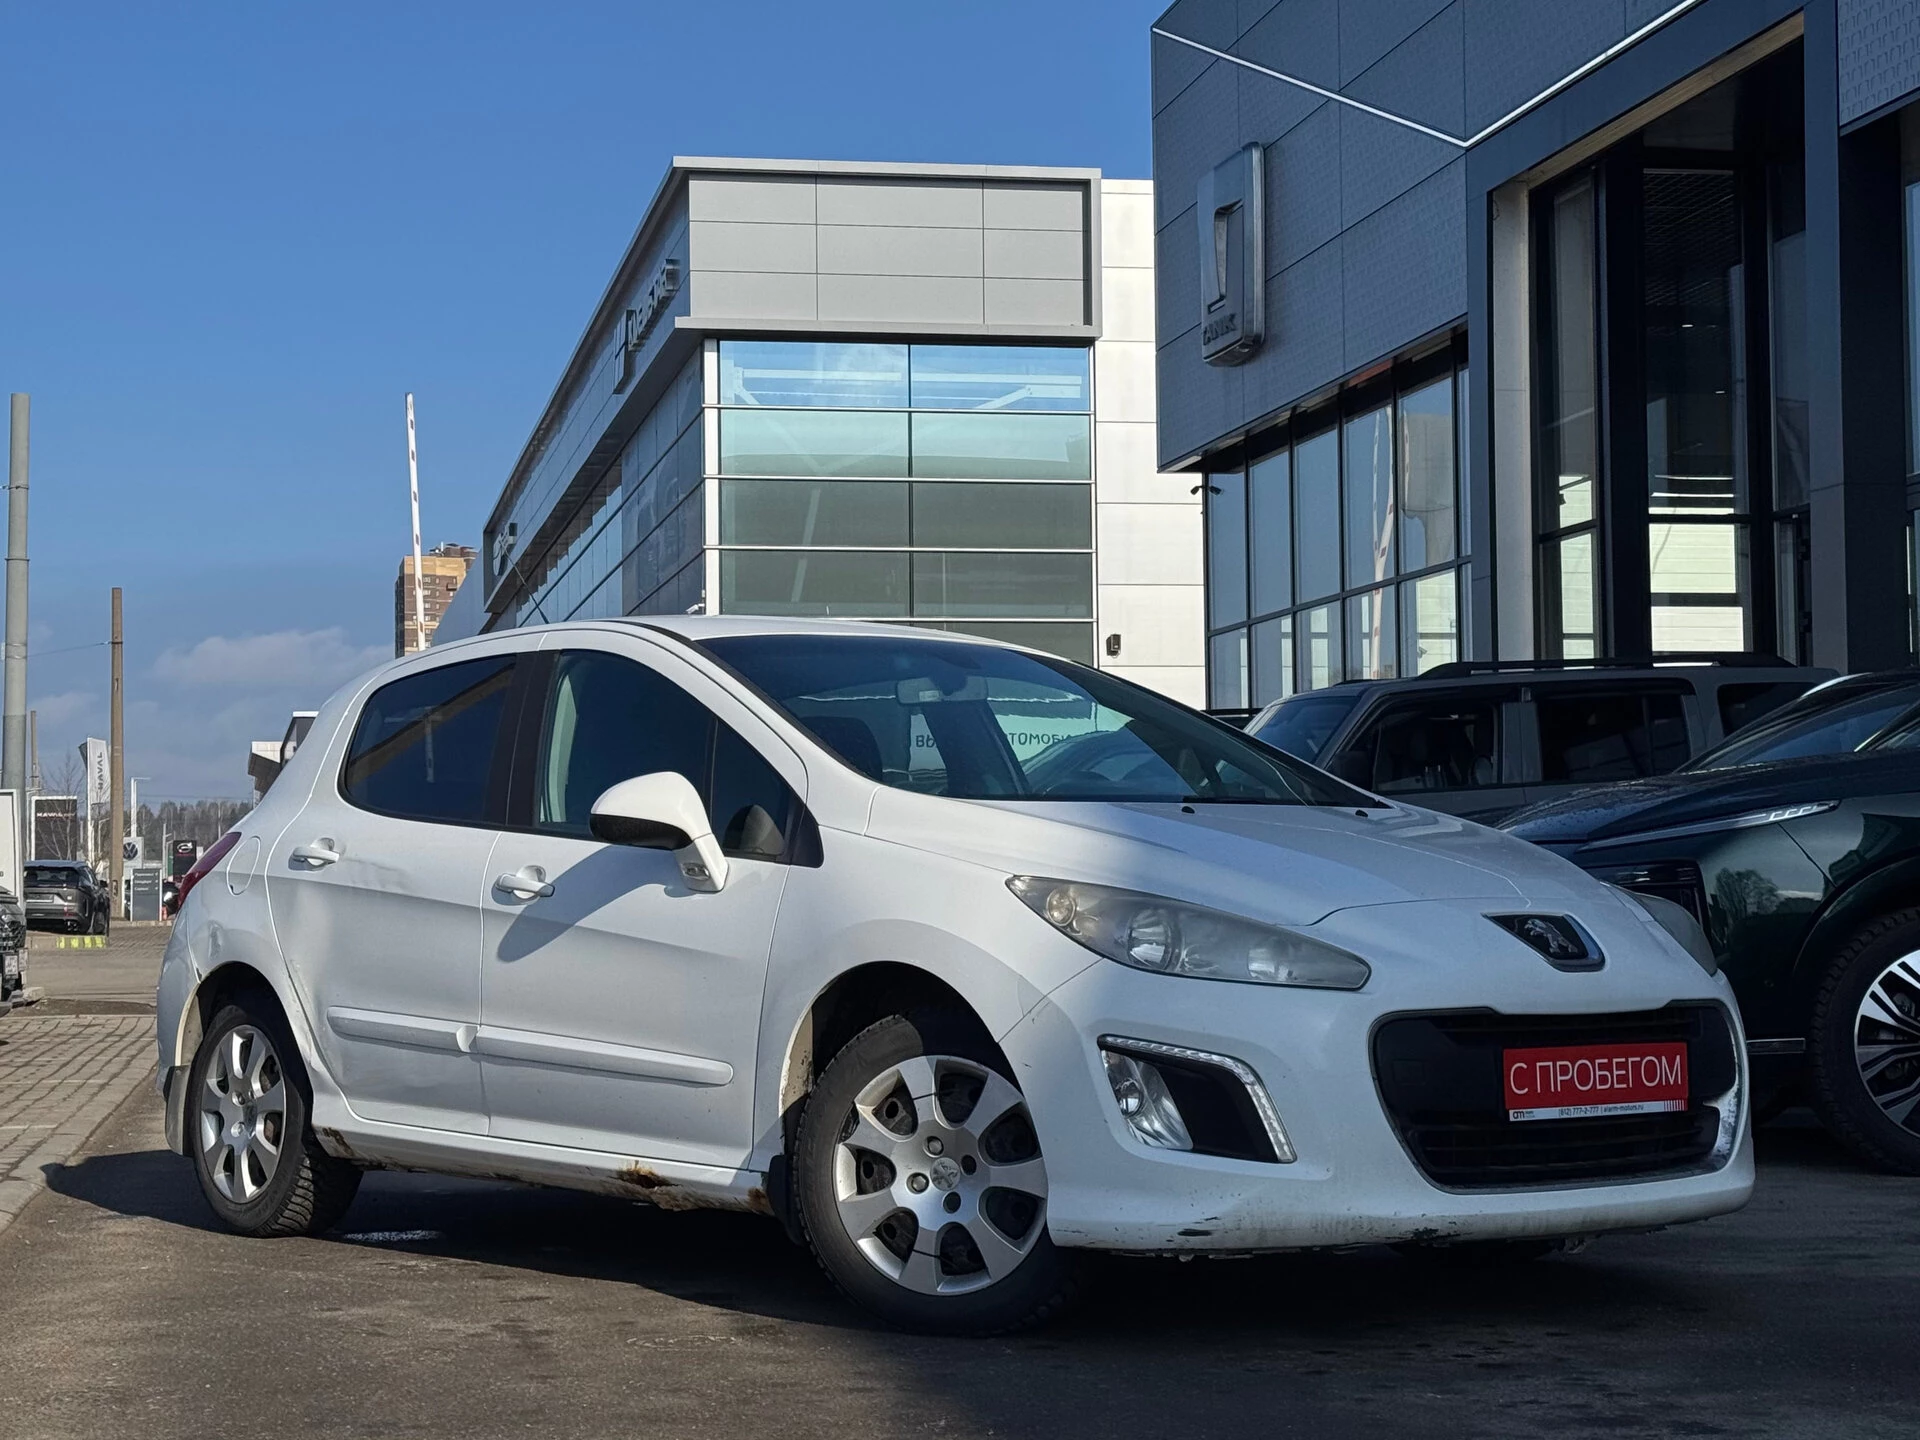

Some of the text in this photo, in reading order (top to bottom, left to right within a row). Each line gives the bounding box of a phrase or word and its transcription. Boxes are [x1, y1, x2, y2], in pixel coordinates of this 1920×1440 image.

[1510, 1054, 1683, 1095] С ПРОБЕГОМ
[1573, 1106, 1599, 1116] 777-2-777
